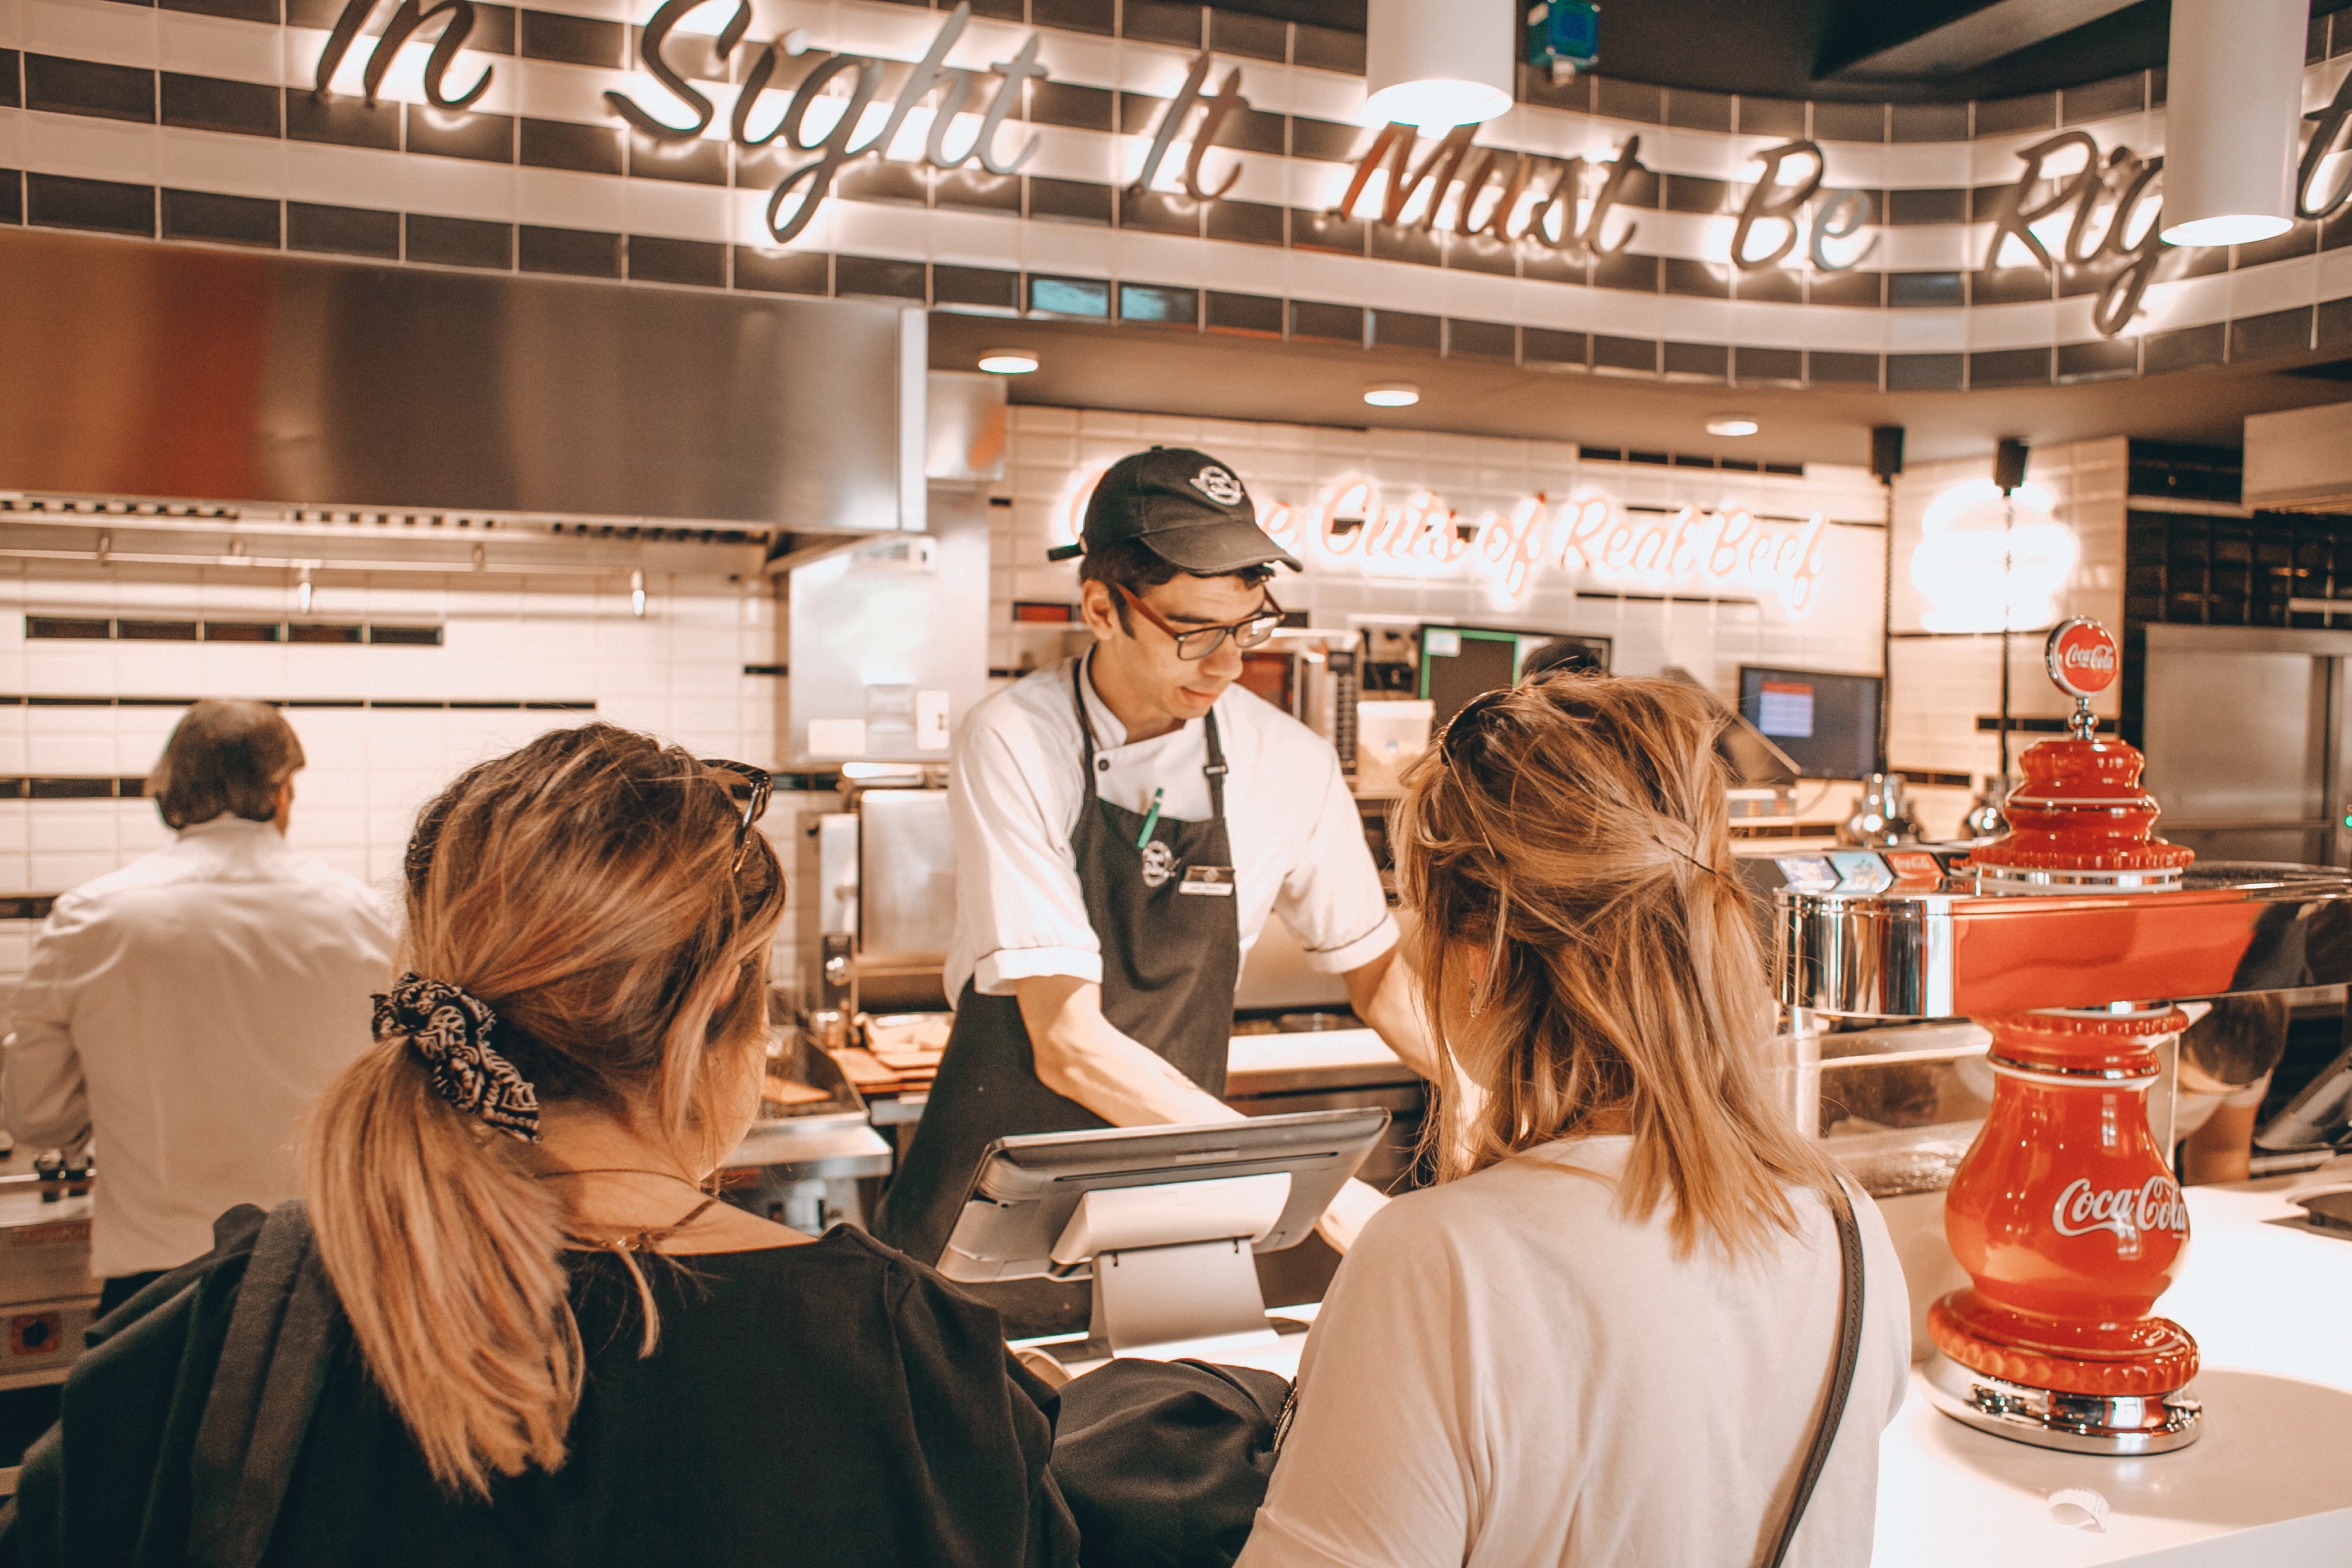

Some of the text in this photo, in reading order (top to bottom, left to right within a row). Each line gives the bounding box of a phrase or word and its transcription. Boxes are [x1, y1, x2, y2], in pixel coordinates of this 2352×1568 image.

[603, 0, 1048, 244] Sight
[1127, 50, 1251, 201] It
[1337, 121, 1647, 255] Must
[1731, 140, 1879, 271] Be
[1320, 477, 1471, 564] Cuts
[1482, 492, 1546, 599] of
[1559, 497, 1702, 575] Real
[1711, 500, 1825, 610] Beef
[2052, 1175, 2186, 1237] Coca-Cola
